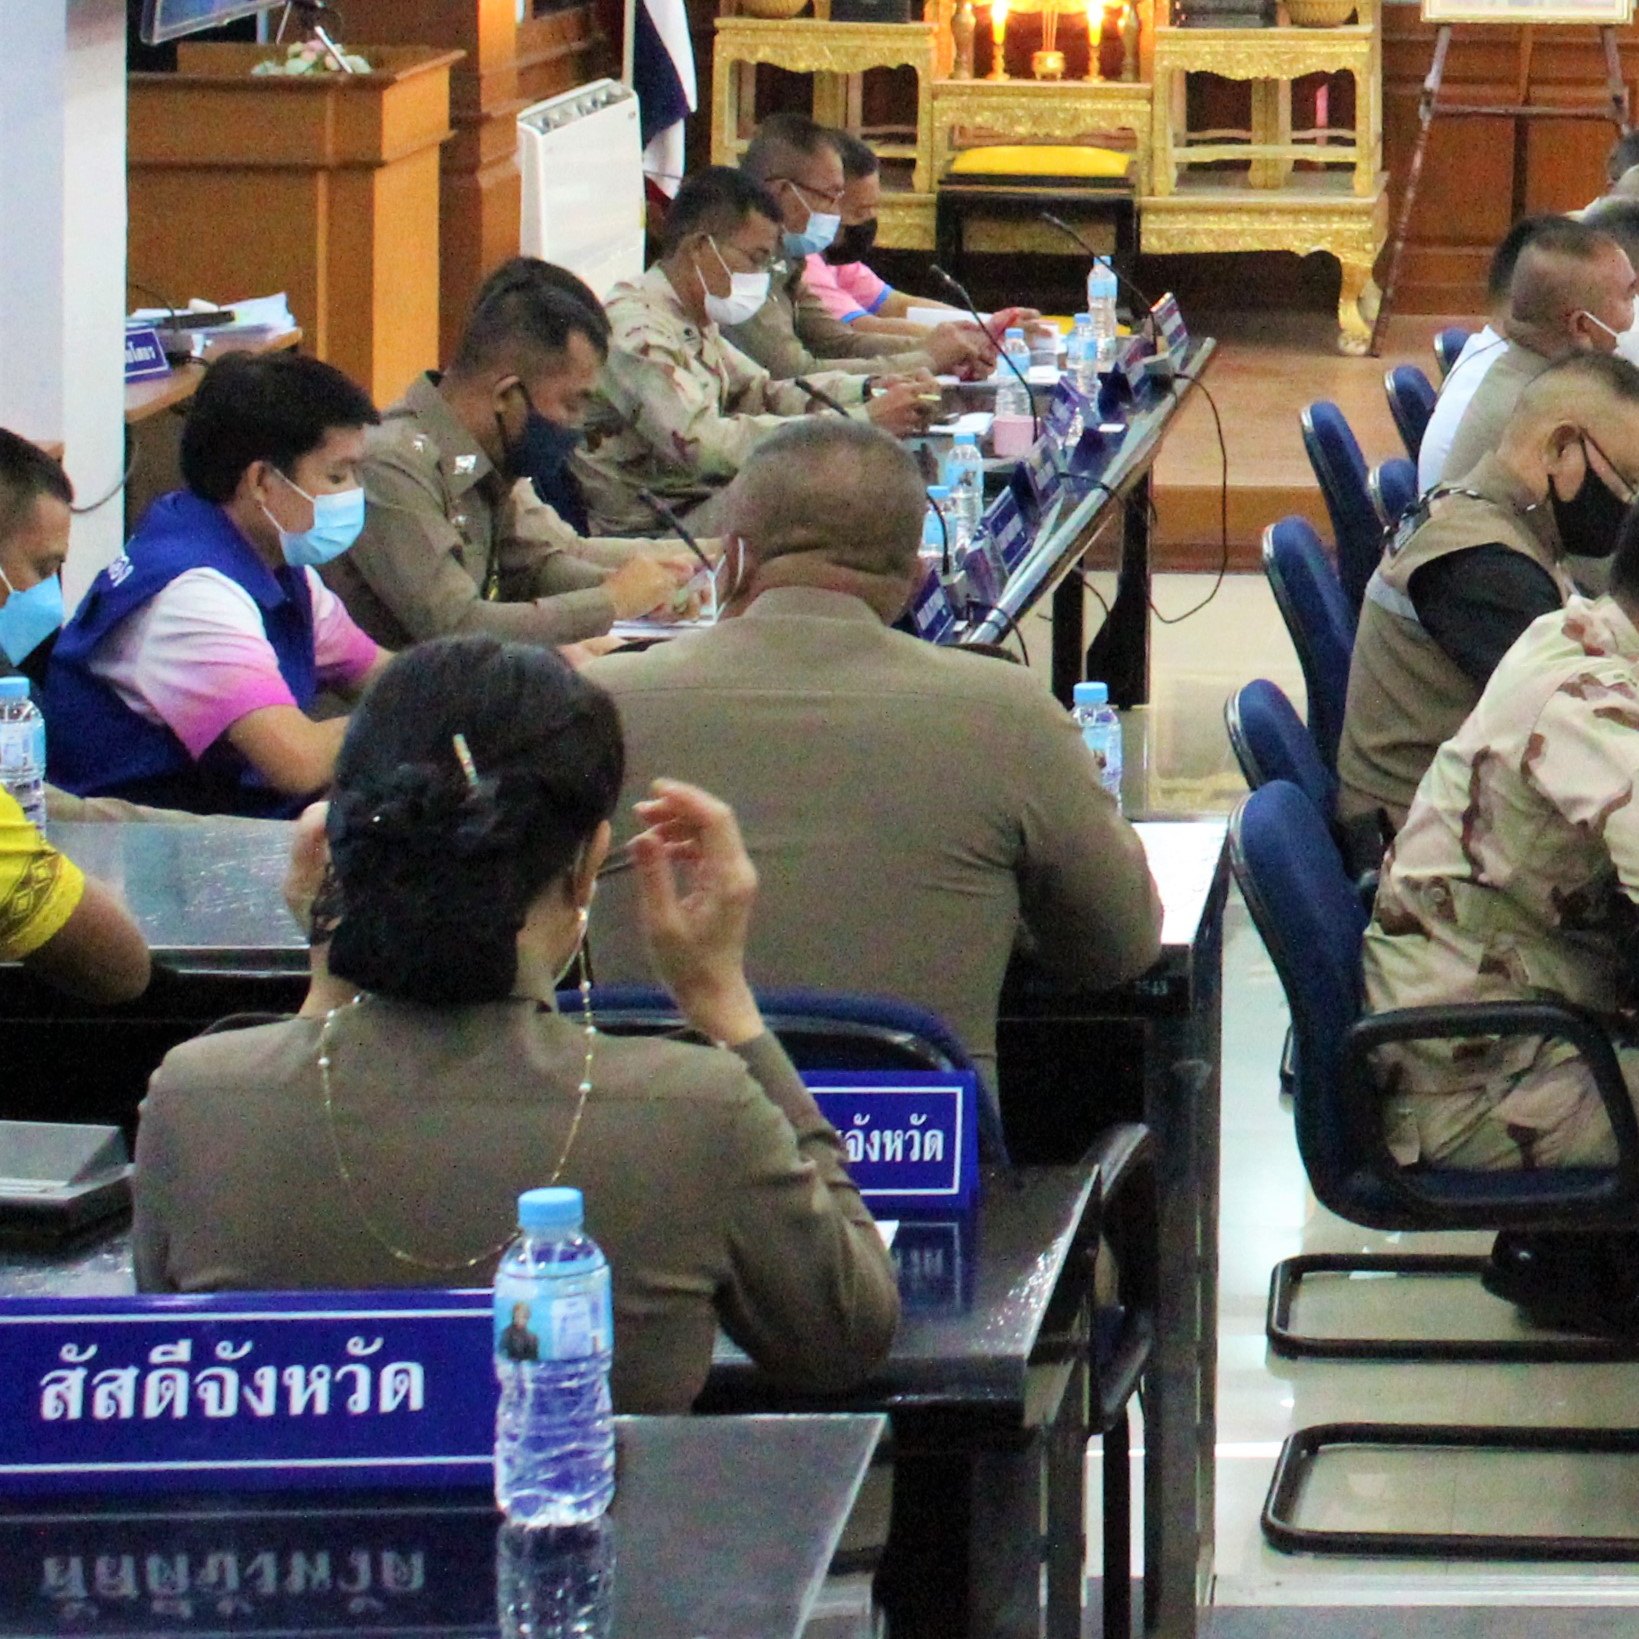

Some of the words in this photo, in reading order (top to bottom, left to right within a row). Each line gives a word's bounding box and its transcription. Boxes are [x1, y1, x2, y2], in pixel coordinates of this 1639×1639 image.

[836, 1113, 945, 1162] จังหวัด
[39, 1335, 426, 1421] สัสดีจังหวัด
